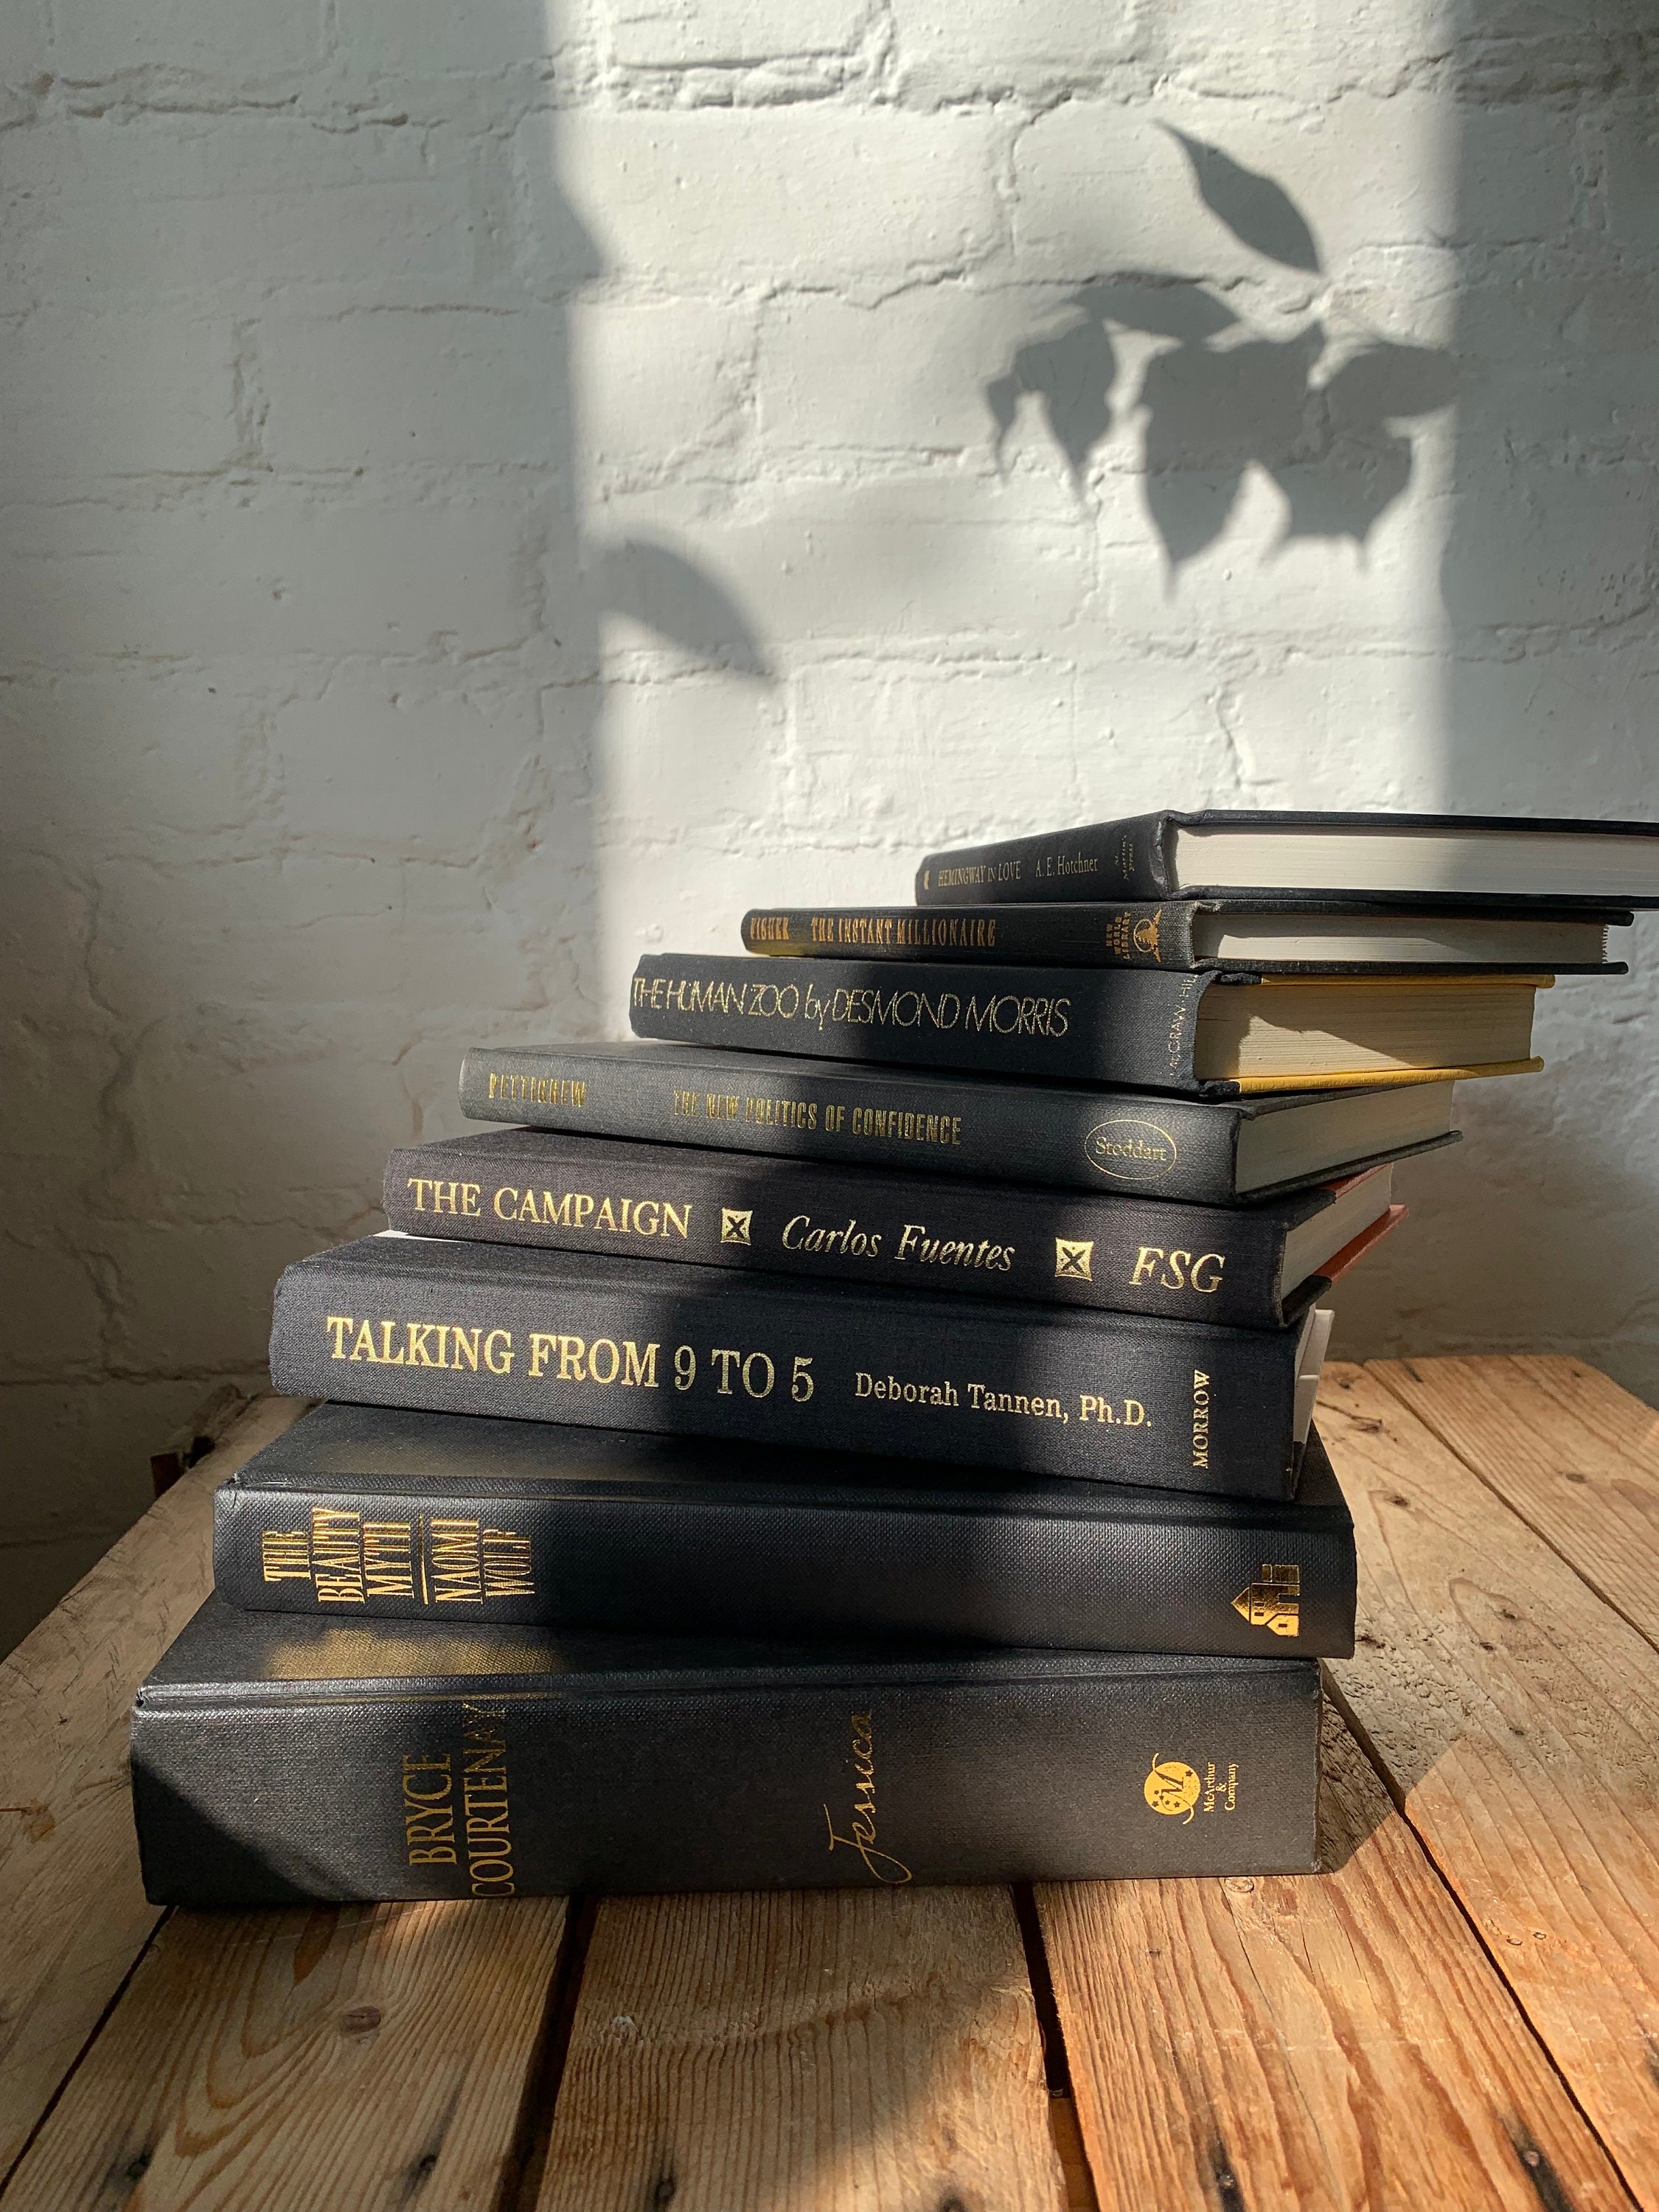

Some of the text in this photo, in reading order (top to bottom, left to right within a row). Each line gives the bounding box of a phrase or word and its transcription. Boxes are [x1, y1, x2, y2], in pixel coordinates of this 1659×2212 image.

[938, 865, 987, 887] HEMINGWAY
[998, 860, 1021, 881] LOVE
[1035, 852, 1098, 877] A. E. Hotchner
[811, 917, 995, 947] THE INSTANT MILLIONAIRE
[633, 977, 1071, 1037] THE HUMAN ZOO by DESMOND MORRIS
[488, 1073, 587, 1107] PETTIGREW
[673, 1090, 963, 1146] THE NEW POLITICS OF CONFIDENCE
[1095, 1135, 1167, 1161] Stoddart
[406, 1178, 692, 1238] THE CAMPAIGN
[782, 1215, 1015, 1271] Carlos Fuentes
[1129, 1246, 1225, 1293] FSG
[326, 1315, 814, 1402] TALKING FROM 9 TO 5
[855, 1371, 1152, 1427] Deborah Tannen, Ph.D.
[1192, 1368, 1211, 1470] MORROW
[261, 1528, 311, 1582] THE
[310, 1507, 365, 1604] BEAUTY
[362, 1521, 414, 1599] MYTH
[430, 1516, 483, 1604] NAOMI
[481, 1528, 535, 1598] WOLF
[402, 1753, 457, 1866] BRYCE
[462, 1702, 515, 1897] COURTENAY
[823, 1709, 913, 1884] Jessica
[1203, 1761, 1216, 1812] McArthur
[1215, 1782, 1227, 1792] &
[1224, 1762, 1239, 1812] Company
